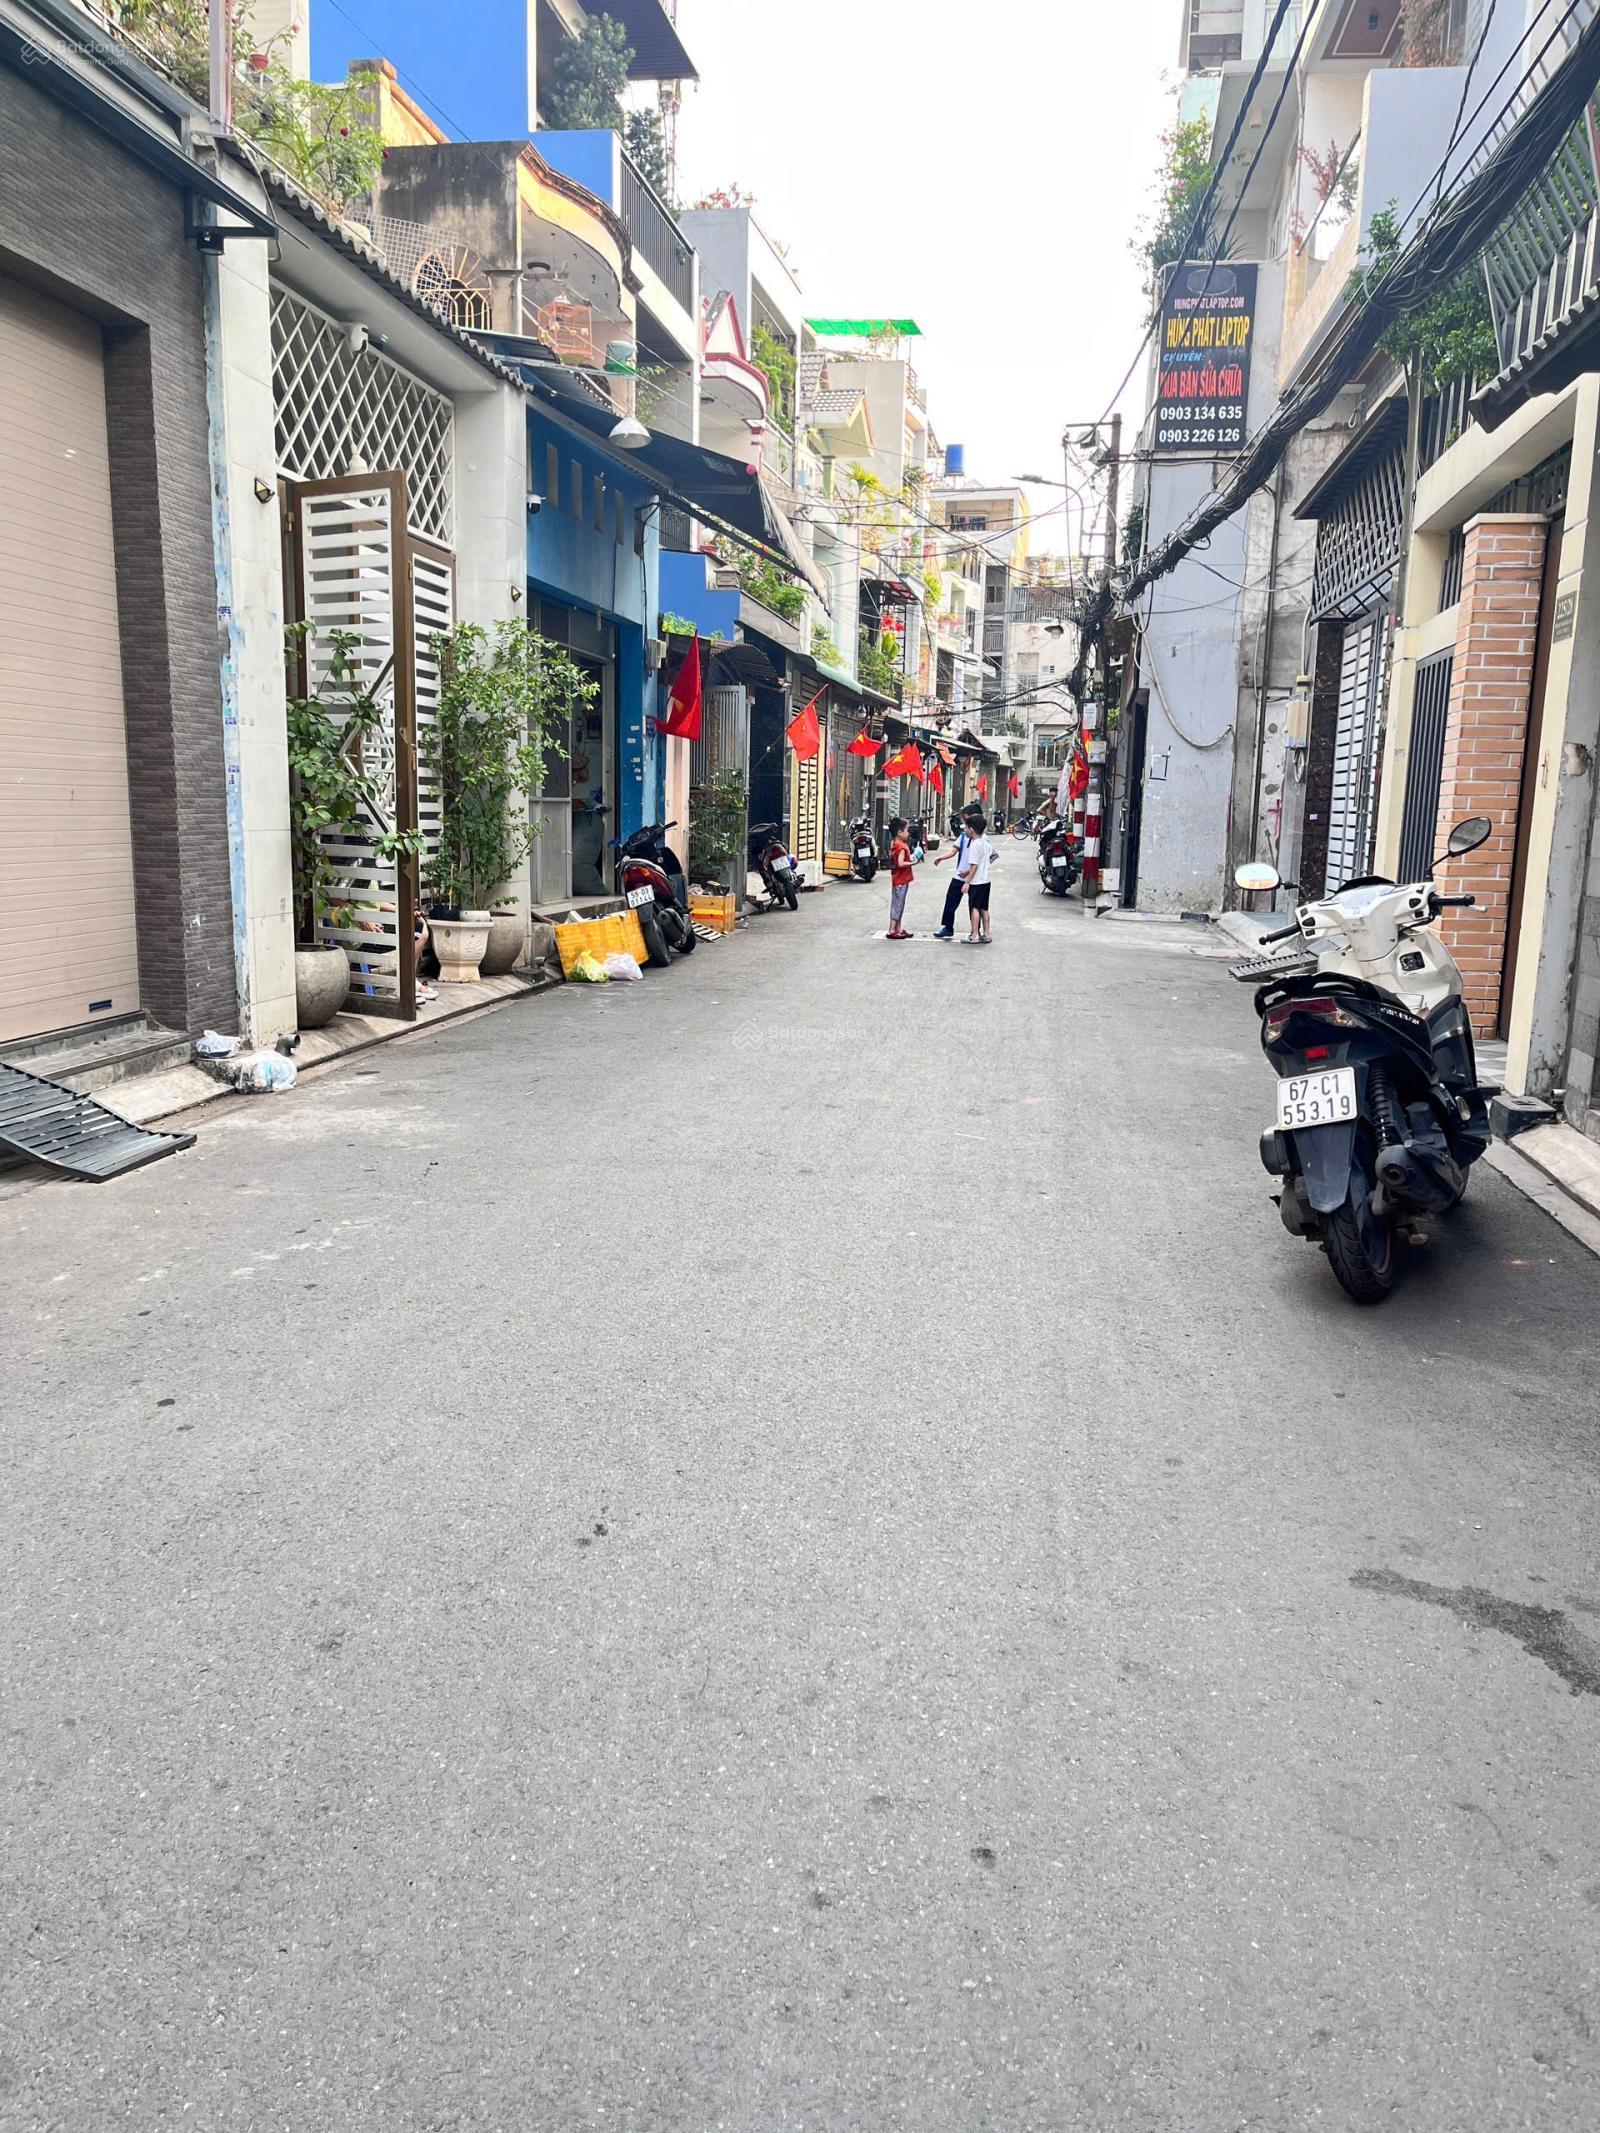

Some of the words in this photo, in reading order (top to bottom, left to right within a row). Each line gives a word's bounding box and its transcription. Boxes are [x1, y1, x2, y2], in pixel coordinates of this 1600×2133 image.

[1191, 311, 1216, 347] PHÁT
[1215, 315, 1250, 347] LAPTOP
[1179, 365, 1199, 398] BÁN
[1160, 407, 1191, 420] 0903
[1193, 406, 1215, 420] 134
[1218, 405, 1242, 419] 635
[1159, 429, 1190, 443] 0903
[1191, 428, 1215, 442] 226
[1217, 428, 1240, 442] 126
[1289, 1074, 1339, 1101] 67-C1
[1283, 1095, 1350, 1125] 553.19
